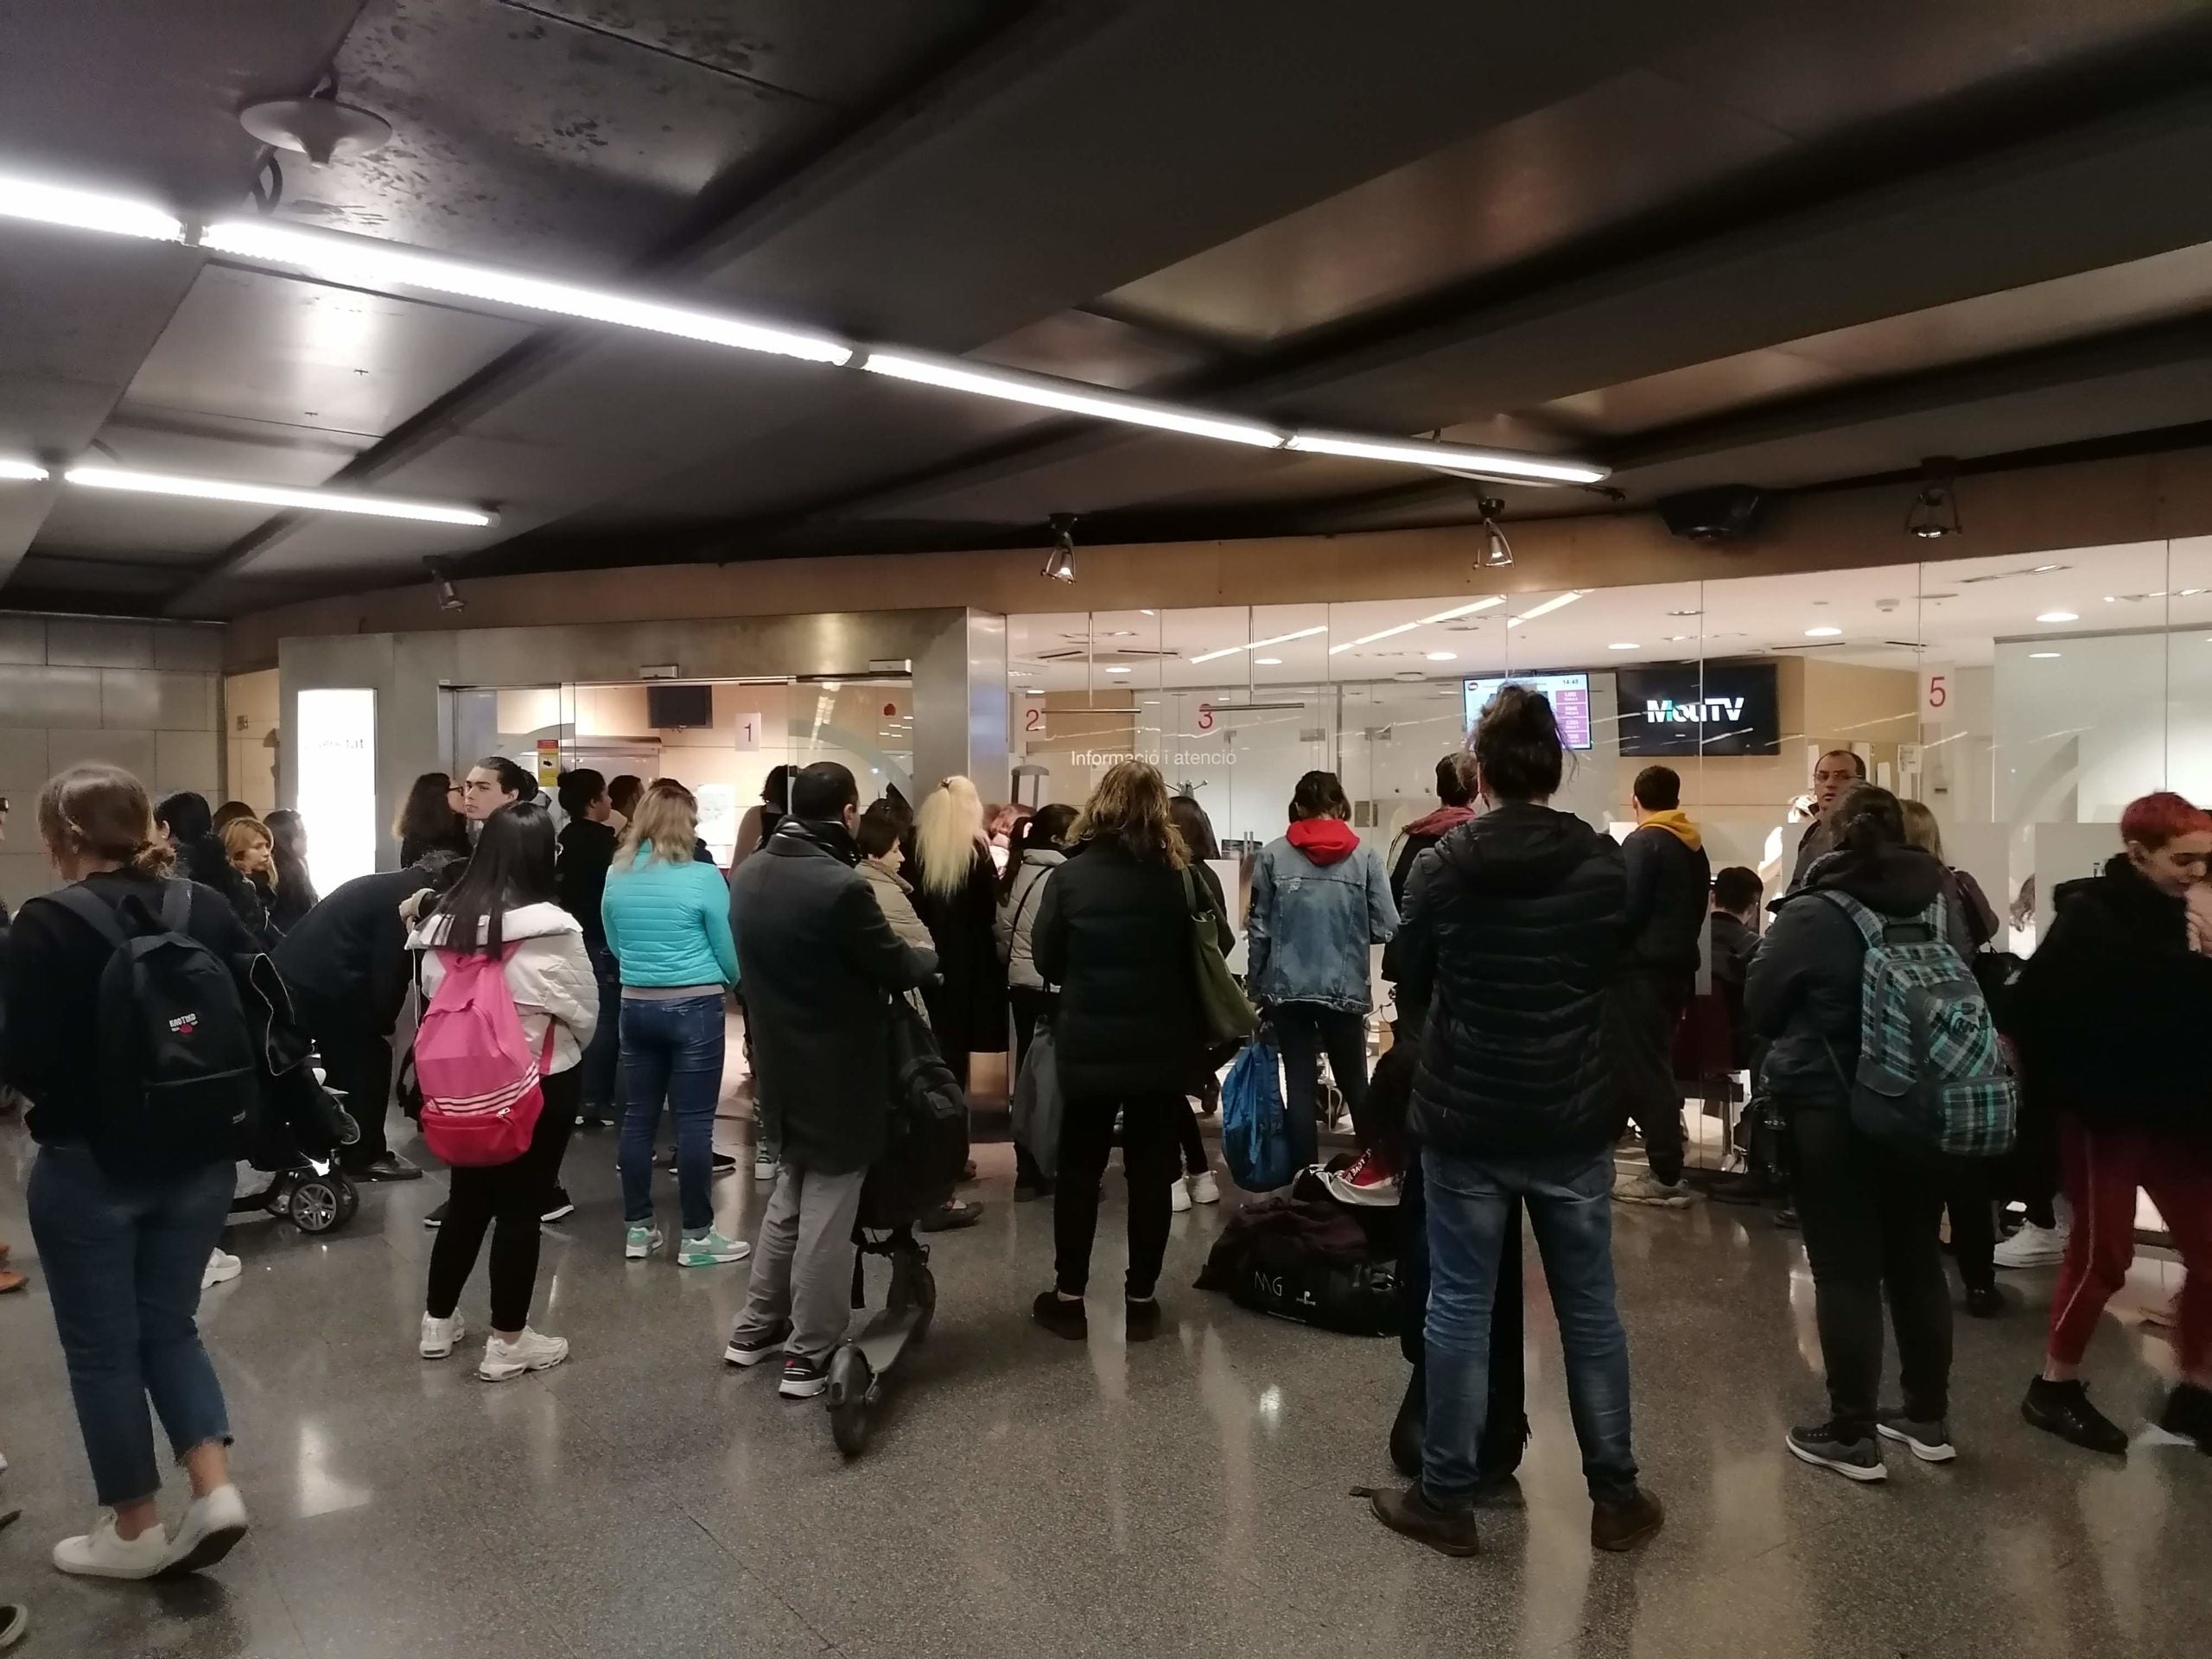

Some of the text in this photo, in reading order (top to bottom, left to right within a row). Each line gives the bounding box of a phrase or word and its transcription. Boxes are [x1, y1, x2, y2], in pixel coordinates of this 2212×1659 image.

[1929, 676, 1946, 708] 5
[1026, 709, 1039, 731] 2
[1198, 703, 1214, 729] 3
[744, 722, 752, 742] 1
[1071, 749, 1237, 766] Informació i atenció
